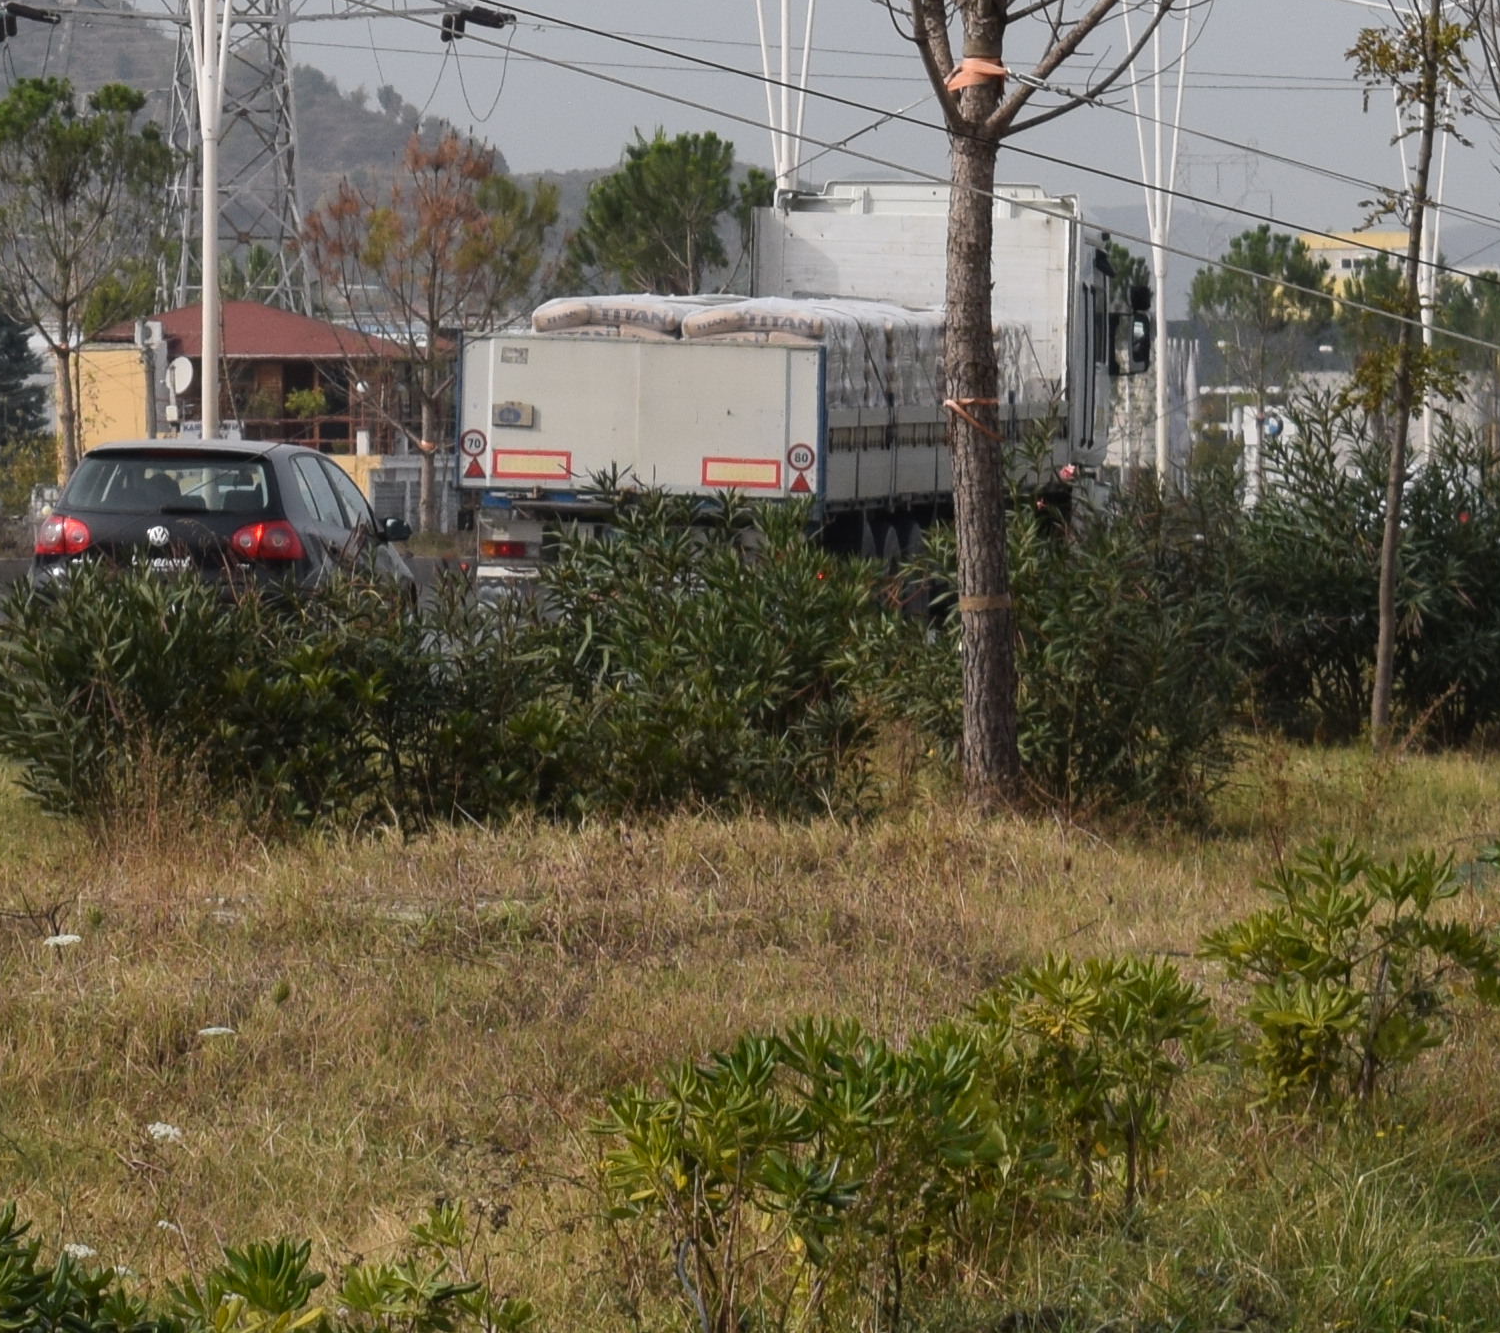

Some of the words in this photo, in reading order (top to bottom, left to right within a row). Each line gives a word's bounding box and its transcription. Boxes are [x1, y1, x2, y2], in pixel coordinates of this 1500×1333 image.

[600, 308, 668, 327] TITAN
[746, 314, 815, 331] TITAN
[467, 438, 481, 449] 70
[794, 452, 809, 463] 80
